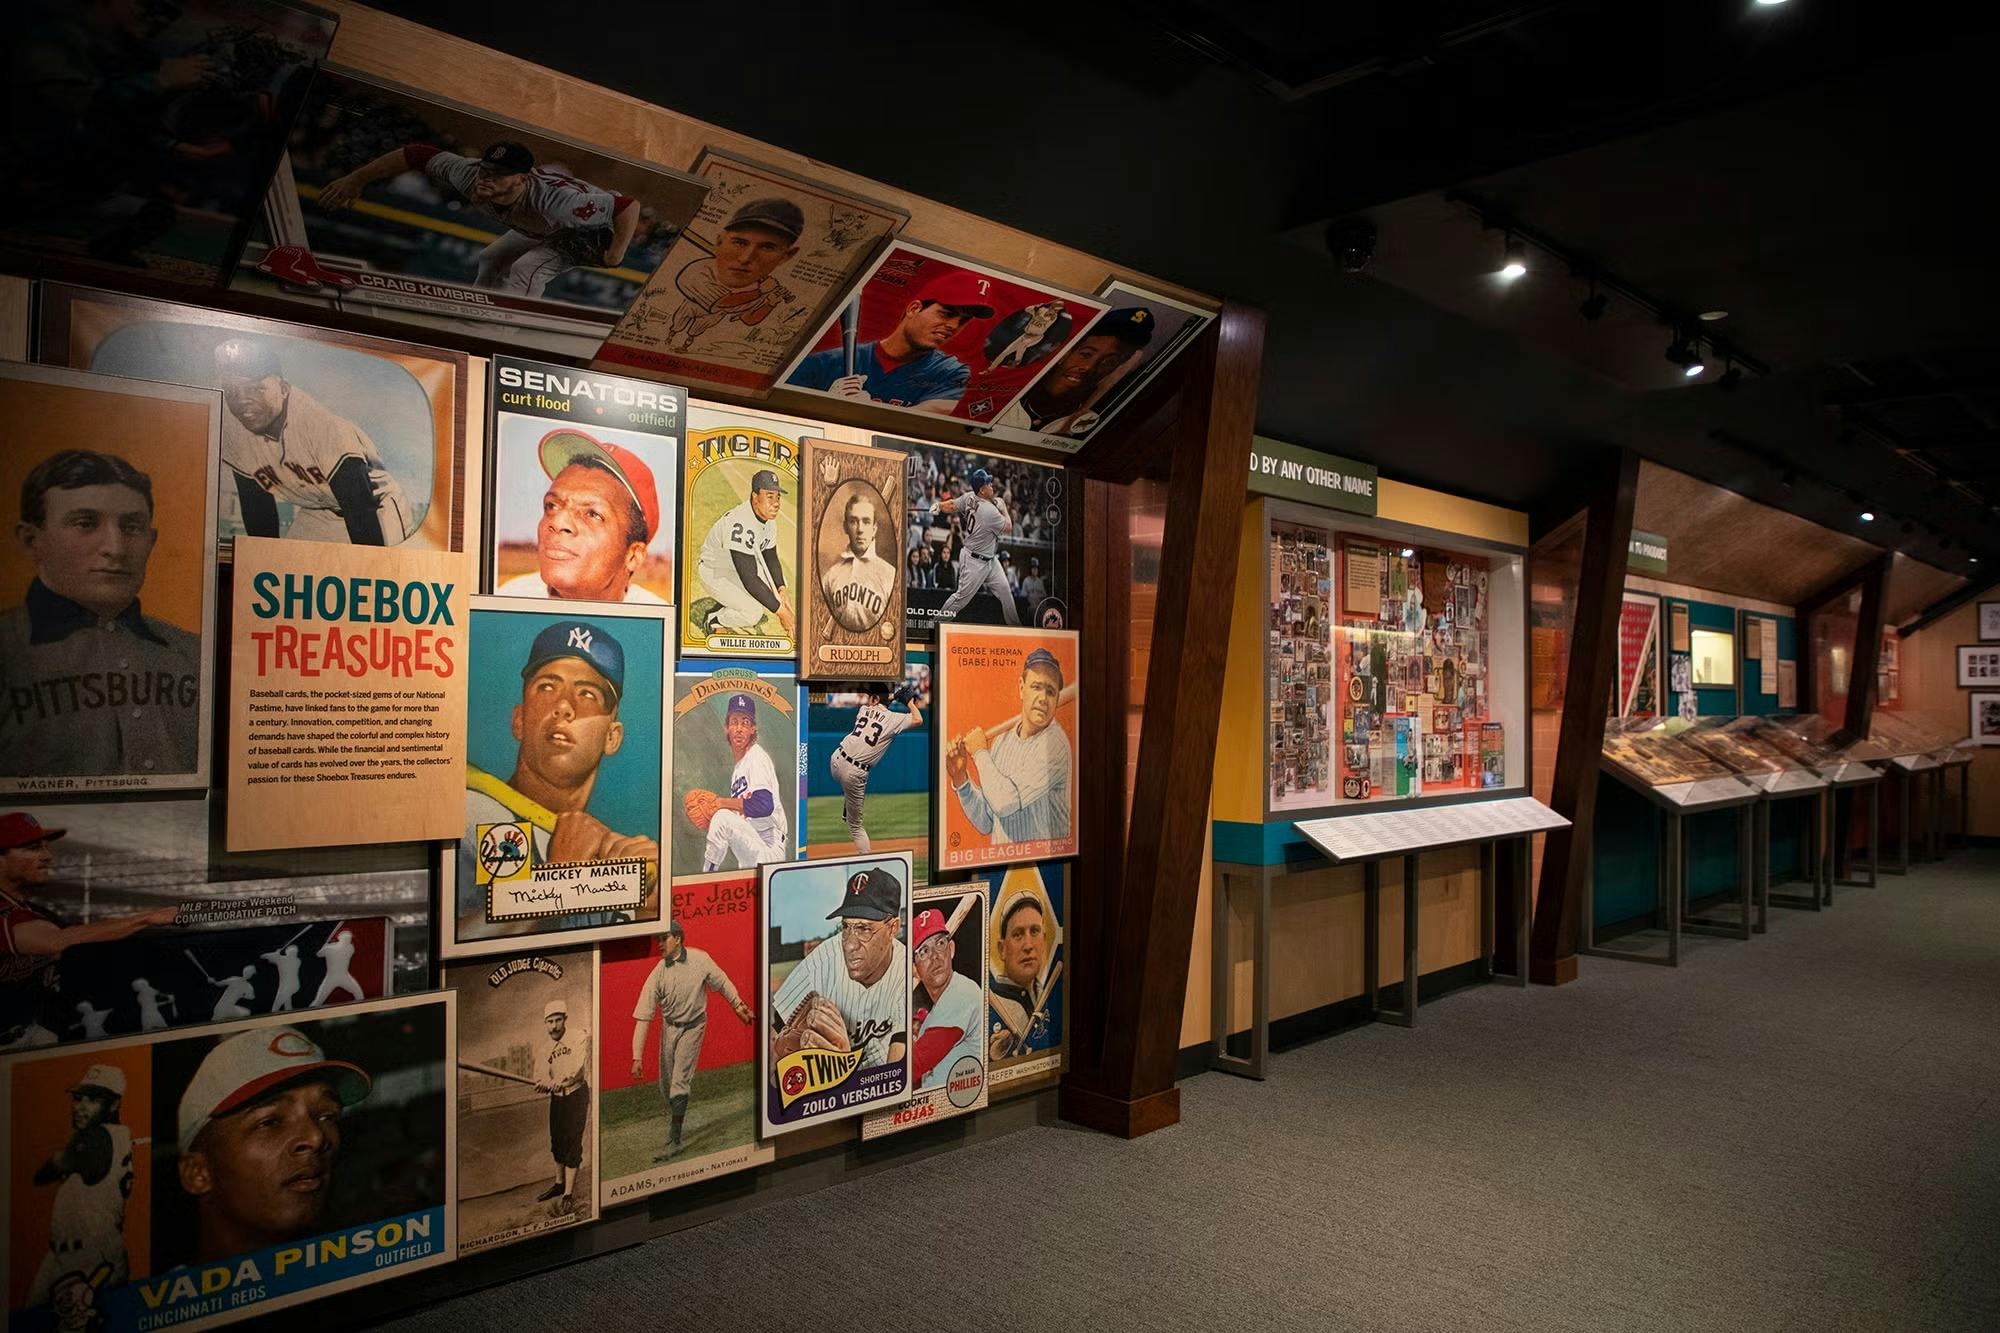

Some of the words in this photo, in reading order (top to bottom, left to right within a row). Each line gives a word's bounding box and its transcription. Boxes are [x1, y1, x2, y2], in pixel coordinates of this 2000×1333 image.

[360, 274, 417, 292] CRAIG
[420, 283, 495, 305] KIMBREL
[500, 366, 678, 414] SENATORS
[502, 392, 532, 407] curt
[536, 395, 570, 413] flood
[628, 410, 676, 429] outfield
[1262, 455, 1278, 475] BY
[1281, 460, 1304, 481] ANY
[1307, 466, 1341, 490] OTHER
[1344, 475, 1373, 497] NAME
[252, 571, 454, 626] SHOEBOX
[832, 582, 883, 616] TORONTO
[926, 609, 957, 618] COLON
[251, 625, 454, 679] TREASURES
[719, 638, 747, 649] WILLIE
[749, 639, 781, 649] HORTON
[951, 646, 986, 655] GEORGE
[989, 647, 1023, 657] HERMAN
[830, 648, 880, 661] RUDOLPH
[958, 657, 990, 667] (BABE)
[992, 658, 1017, 667] RUTH
[715, 669, 753, 679] DONRUSS
[8, 671, 198, 725] PITTSBURG
[250, 690, 283, 698] Baseball
[310, 690, 323, 698] the
[325, 691, 371, 700] pocket-sized
[373, 692, 392, 700] gems
[416, 691, 445, 699] National
[695, 680, 743, 699] DIAMOND
[743, 680, 773, 699] KINGS
[285, 704, 303, 712] have
[305, 704, 328, 712] linked
[330, 704, 346, 712] fans
[370, 705, 391, 713] game
[392, 704, 402, 712] for
[424, 704, 439, 712] than
[864, 710, 886, 722] NOMO
[335, 718, 383, 727] competition,
[400, 718, 432, 727] changing
[851, 717, 883, 747] 23
[287, 732, 305, 740] have
[307, 732, 334, 741] shaped
[395, 732, 424, 740] complex
[426, 731, 450, 740] history
[248, 747, 256, 755] of
[293, 746, 316, 754] cards.
[318, 745, 338, 753] While
[341, 745, 352, 753] the
[354, 745, 385, 753] financial
[401, 744, 443, 752] sentimental
[248, 761, 269, 769] value
[271, 761, 279, 769] of
[281, 760, 302, 768] cards
[304, 760, 318, 768] has
[403, 758, 415, 766] the
[17, 780, 79, 790] WAGNER,
[85, 777, 148, 787] PITTSBURG
[248, 776, 278, 785] passion
[293, 774, 315, 782] these
[317, 773, 349, 781] Shoebox
[351, 772, 385, 780] Treasures
[387, 771, 416, 779] endures.
[951, 850, 974, 864] BIG
[980, 844, 1032, 860] LEAGUE
[534, 868, 583, 882] MICKEY
[590, 864, 638, 878] MANTLE
[211, 899, 247, 911] Players
[250, 896, 294, 907] Weekend
[509, 887, 563, 909] Mickey
[570, 880, 629, 897] Mantle
[672, 891, 695, 907] er
[706, 883, 756, 903] Jack
[175, 908, 262, 924] COMMEMORATIVE
[266, 905, 296, 916] PATCH
[672, 901, 748, 919] PLAYERS
[490, 966, 508, 985] OLD
[507, 957, 531, 975] JUDGE
[802, 1054, 857, 1088] TWINS
[860, 1068, 902, 1086] SHORTSTOP
[990, 1069, 1014, 1082] AEFER
[949, 1075, 981, 1093] PHILLIES
[802, 1096, 836, 1116] ZOILO
[842, 1079, 902, 1106] VERSALLES
[893, 1103, 935, 1125] ROJAS
[611, 1178, 656, 1198] ADAMS,
[659, 1167, 704, 1184] PITTSBURGH
[711, 1156, 748, 1171] NATIONALS
[138, 1259, 263, 1310] VADA
[275, 1214, 431, 1277] PINSON
[375, 1241, 432, 1268] OUTFIELD
[138, 1297, 223, 1332] CINCINNATI
[232, 1286, 266, 1306] REDS
